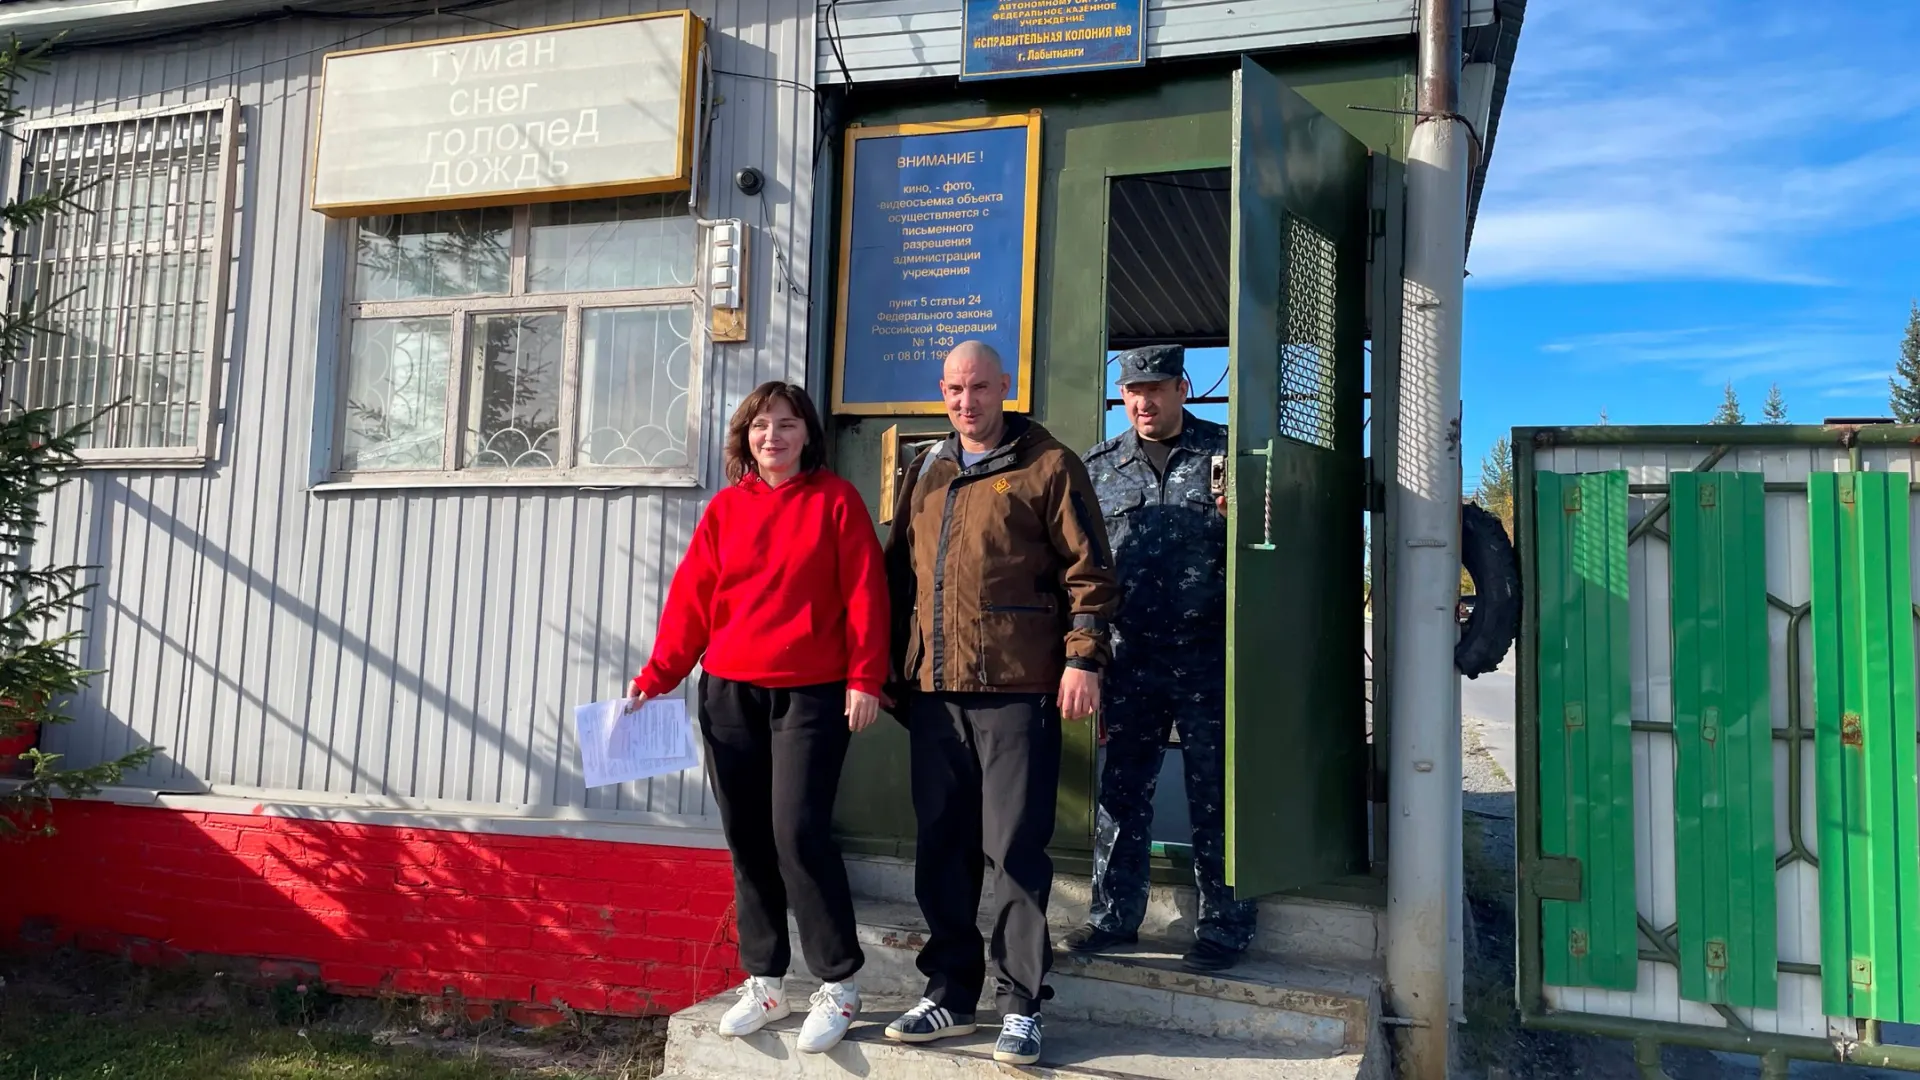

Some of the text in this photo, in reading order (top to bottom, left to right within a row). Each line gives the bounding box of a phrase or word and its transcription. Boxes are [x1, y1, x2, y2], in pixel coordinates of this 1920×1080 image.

[992, 7, 1063, 20] ФЕДЕРАЛЬНОЕ
[1020, 14, 1085, 27] УЧРЕЖДЕНИЕ
[973, 24, 1132, 49] ИСПРАВИТЕЛЬНАЯ КОЛОНИЯ №8
[428, 36, 556, 85] туман
[1018, 47, 1085, 62] г. Лабытнанги
[449, 82, 538, 117] снег
[426, 108, 599, 159] гололед
[898, 151, 976, 168] ВНИМАНИЕ
[426, 151, 569, 194] дождь
[903, 184, 931, 195] кино,
[943, 181, 975, 193] фото,
[957, 192, 1003, 205] объекта
[888, 208, 989, 224] осуществляется с
[902, 223, 974, 236] письменного
[903, 238, 972, 251] разрешения
[893, 252, 981, 265] администрации
[902, 266, 971, 280] учреждения
[889, 294, 982, 310] пункт 5 статьи 24
[877, 309, 993, 322] Федерального закона
[871, 323, 997, 335] Российской Федерации
[912, 336, 954, 347] № 1-ФЗ
[883, 350, 950, 361] от 08.01.199
